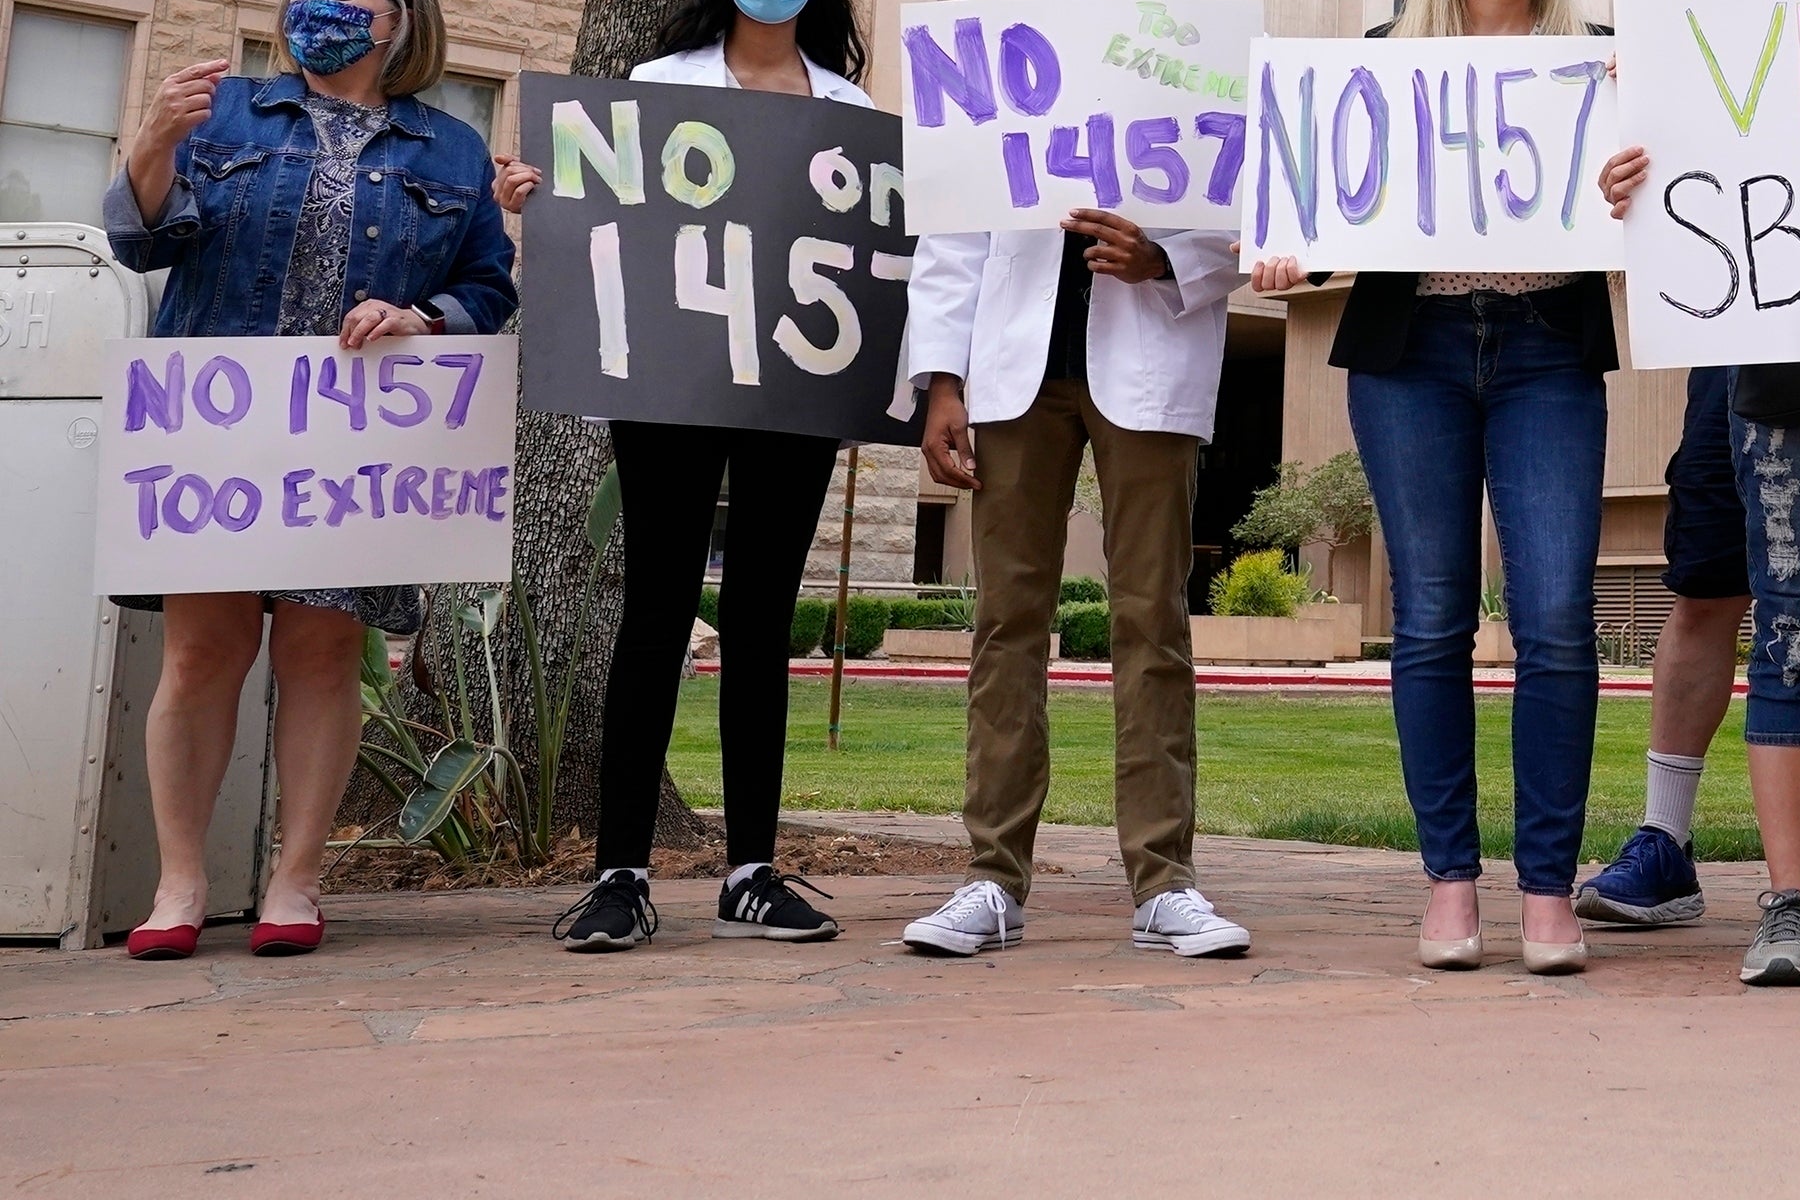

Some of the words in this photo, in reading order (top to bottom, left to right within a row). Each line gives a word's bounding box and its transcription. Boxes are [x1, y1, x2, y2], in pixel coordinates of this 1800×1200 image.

[902, 17, 1062, 128] NO
[1102, 32, 1247, 102] EXTREME
[552, 100, 736, 209] NO
[1002, 111, 1247, 209] 1457
[1254, 60, 1390, 251] NO
[1412, 60, 1606, 238] 1457
[124, 351, 253, 435] NO
[289, 353, 484, 435] 1457
[124, 464, 263, 540] TOO
[281, 463, 510, 527] EXTREME
